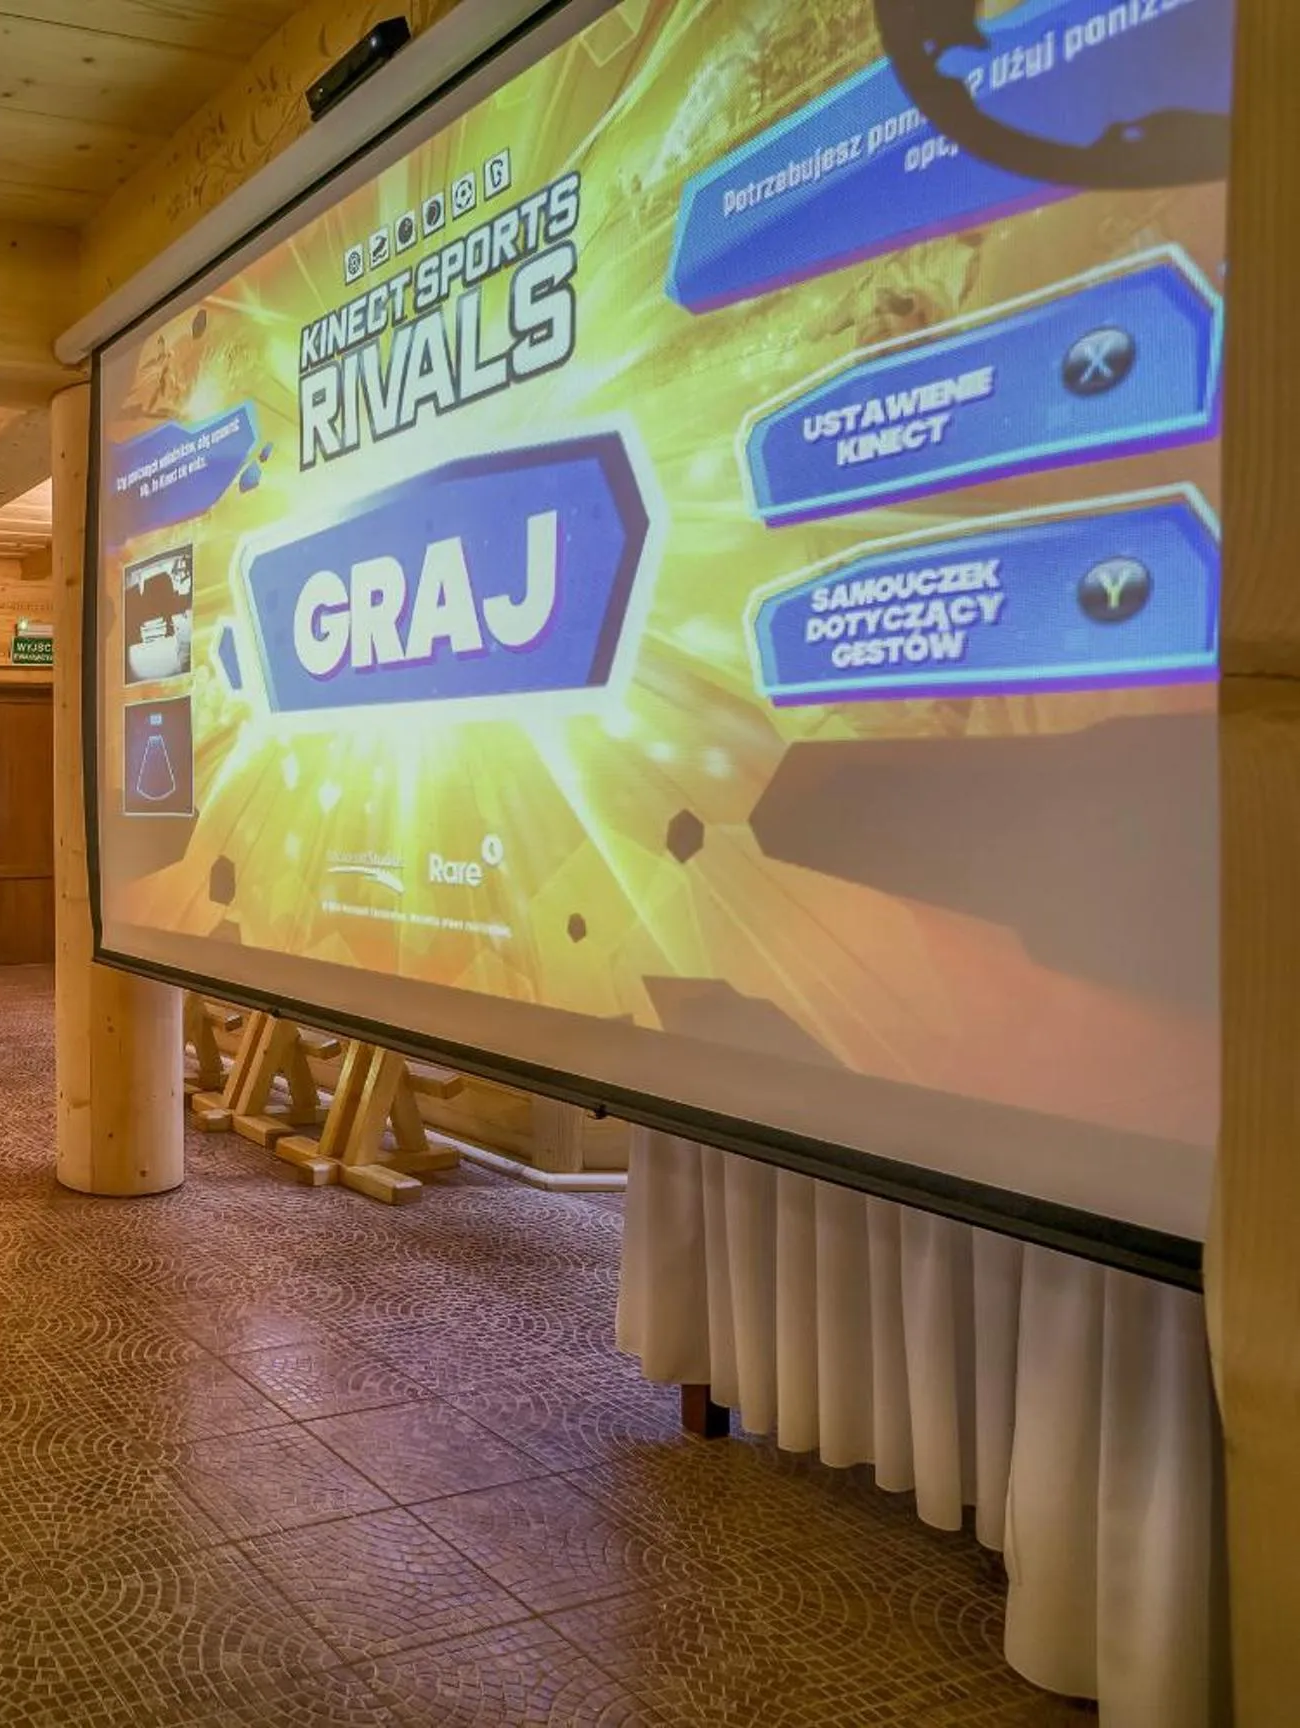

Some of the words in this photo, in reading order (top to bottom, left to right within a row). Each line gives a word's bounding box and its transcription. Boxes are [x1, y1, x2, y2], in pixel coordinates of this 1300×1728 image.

[723, 133, 864, 218] Potrzebujesz
[301, 267, 412, 373] KINECT
[414, 170, 581, 311] SPORTS
[300, 238, 579, 471] RIVALS
[803, 366, 996, 442] USTAWIENIE
[836, 413, 952, 467] KINECT
[294, 510, 559, 678] GRAJ
[805, 593, 1004, 643] DOTYCZĄCY
[811, 559, 1001, 614] SAMOUCZEK
[429, 852, 483, 887] Rare
